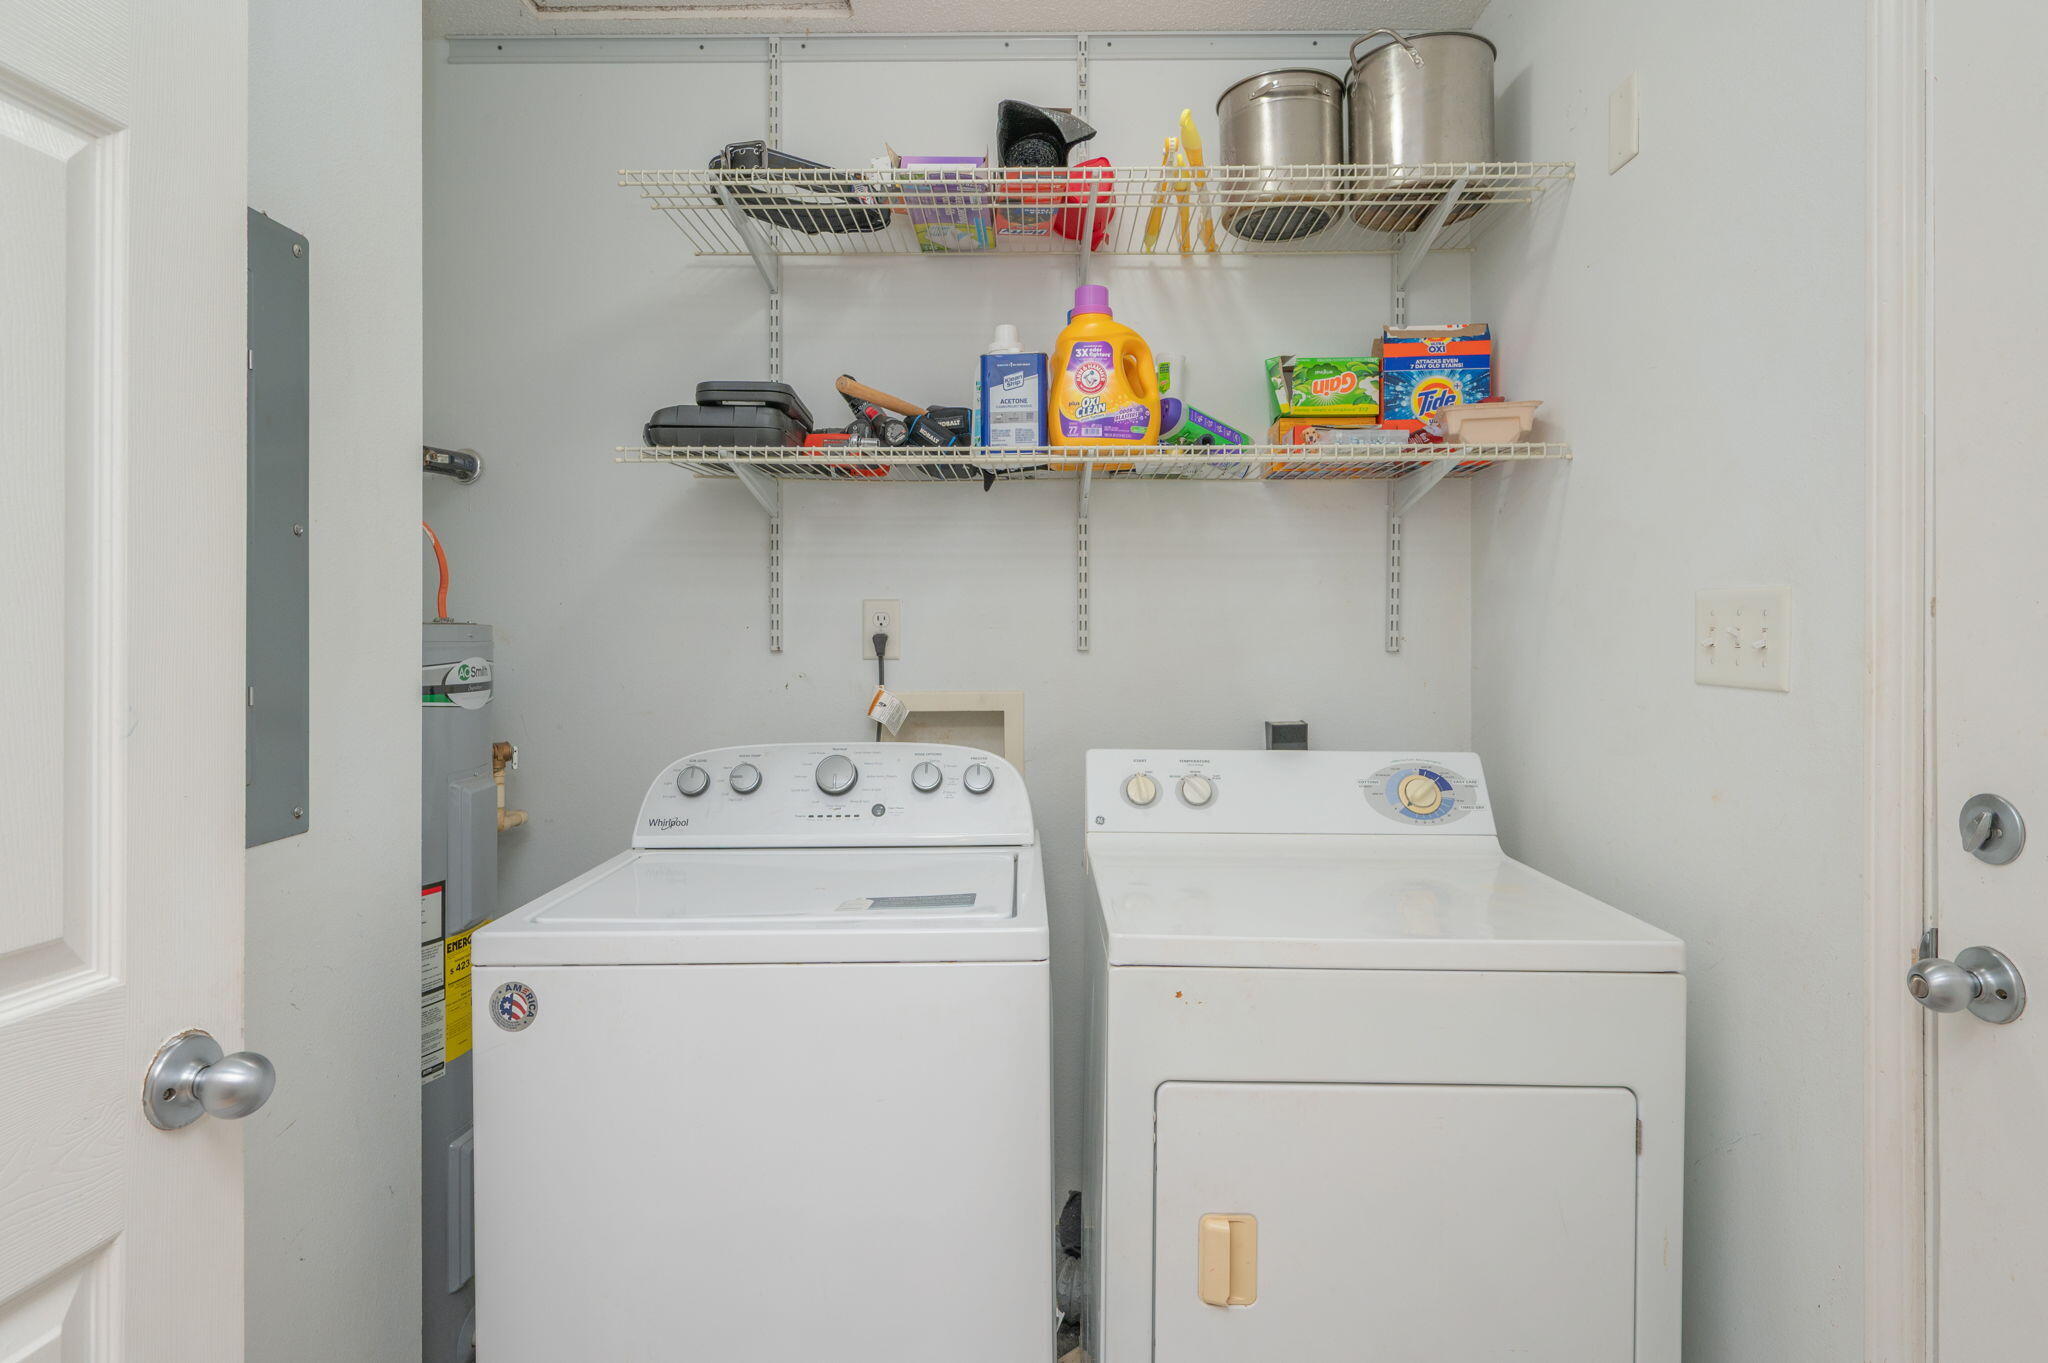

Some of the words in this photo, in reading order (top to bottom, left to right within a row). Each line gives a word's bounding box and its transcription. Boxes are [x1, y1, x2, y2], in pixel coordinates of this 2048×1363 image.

[1075, 348, 1089, 358] 3X
[1428, 345, 1446, 353] OXI
[1311, 372, 1357, 396] Gain
[1081, 396, 1100, 407] OXI
[1418, 389, 1457, 416] Tide
[1075, 402, 1107, 418] CLEAN
[938, 419, 961, 427] KOBALT
[919, 427, 940, 444] KOBALT
[1068, 426, 1078, 434] 77
[648, 817, 689, 830] Whirlpool
[505, 983, 536, 1018] AMERICA
